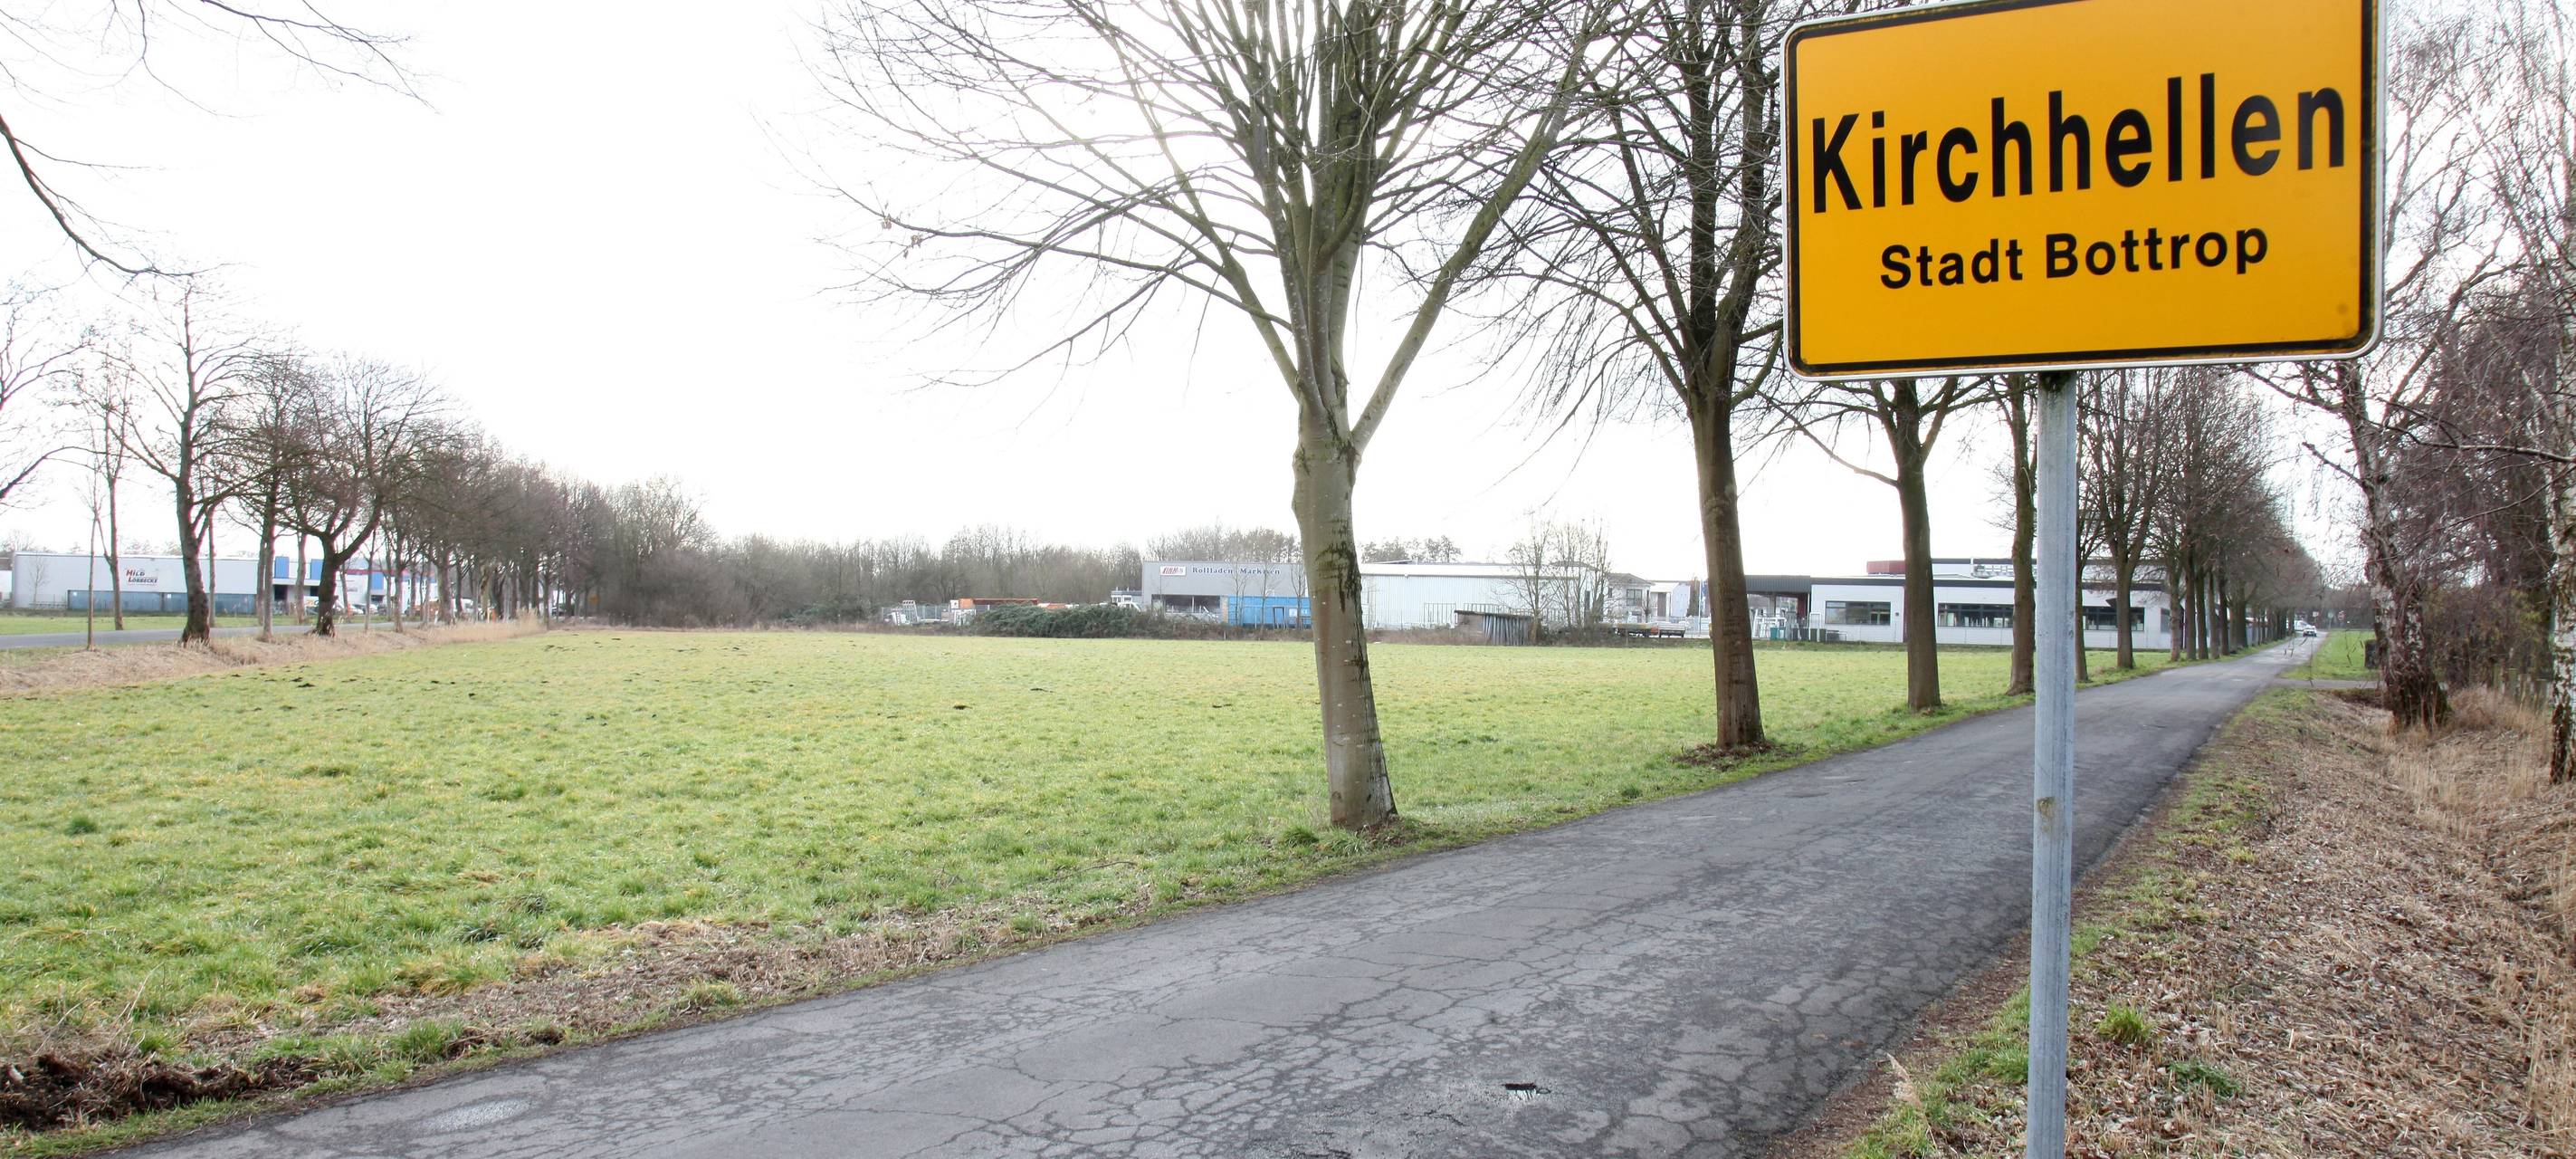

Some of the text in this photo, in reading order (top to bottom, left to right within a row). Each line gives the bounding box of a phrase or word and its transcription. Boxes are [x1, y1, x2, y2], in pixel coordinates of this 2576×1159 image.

[1812, 72, 2344, 214] Kirchhellen
[1880, 227, 2268, 290] Stadt Bottrop
